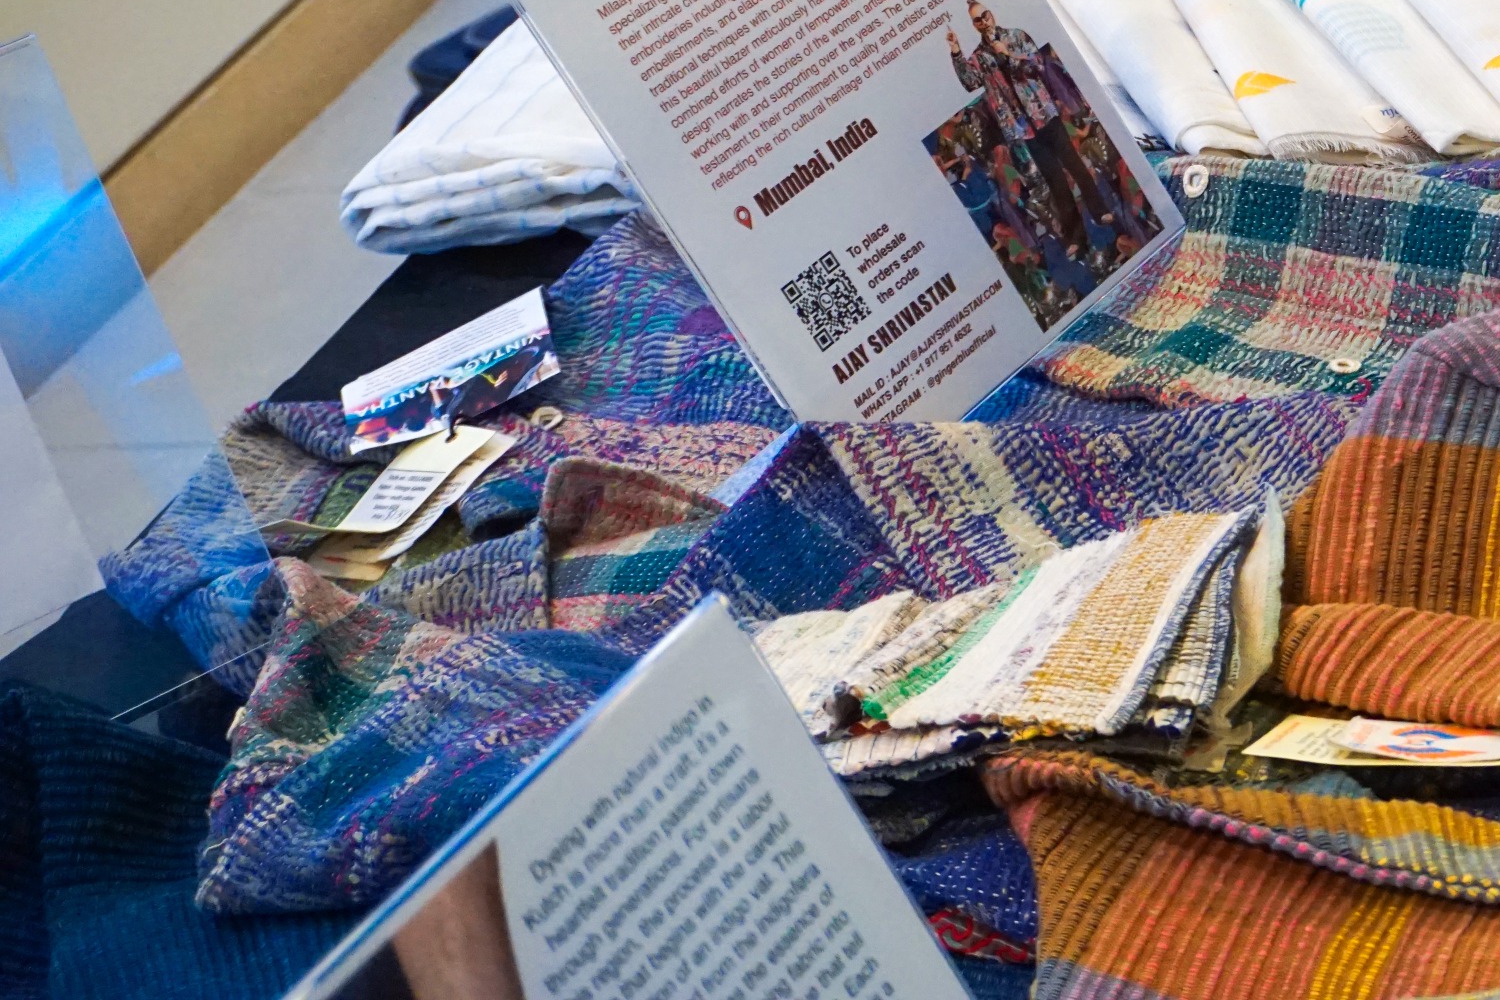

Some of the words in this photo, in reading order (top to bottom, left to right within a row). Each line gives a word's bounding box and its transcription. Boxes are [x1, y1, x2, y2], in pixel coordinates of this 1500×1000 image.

[618, 30, 641, 50] their
[642, 4, 681, 34] intricate
[630, 19, 692, 65] embroideries
[640, 26, 717, 81] embellishments,
[717, 9, 736, 28] and
[649, 58, 698, 96] traditional
[697, 24, 749, 63] techniques
[749, 10, 770, 26] with
[659, 96, 679, 112] this
[678, 64, 721, 99] beautiful
[719, 45, 750, 69] blazer
[751, 5, 808, 48] meticulously
[670, 88, 718, 128] combined
[718, 69, 748, 94] efforts
[759, 36, 794, 64] women
[681, 116, 714, 143] design
[714, 88, 753, 119] narrates
[753, 76, 770, 91] the
[771, 53, 802, 79] stories
[812, 34, 829, 48] the
[829, 10, 863, 36] women
[690, 128, 730, 159] working
[729, 113, 749, 130] with
[750, 97, 769, 116] and
[769, 63, 819, 102] supporting
[818, 48, 838, 66] over
[838, 37, 855, 51] the
[855, 18, 883, 42] years.
[881, 3, 902, 18] The
[700, 135, 749, 174] testament
[759, 111, 781, 131] their
[782, 70, 838, 115] commitment
[849, 42, 878, 67] quality
[879, 26, 897, 45] and
[897, 7, 926, 31] artistic
[711, 154, 757, 190] reflecting
[755, 142, 772, 157] the
[772, 128, 791, 145] rich
[791, 100, 825, 131] cultural
[824, 75, 862, 106] heritage
[872, 47, 901, 70] Indian
[901, 10, 952, 50] embroidery.
[753, 148, 834, 216] Mumbai,
[825, 118, 877, 162] India
[845, 245, 861, 257] To
[861, 223, 889, 250] place
[857, 232, 906, 273] wholesale
[867, 260, 900, 288] orders
[900, 240, 925, 262] scan
[876, 287, 894, 303] the
[895, 267, 919, 289] code
[452, 334, 544, 378] VINTAGE
[832, 343, 869, 384] AJAY
[867, 272, 956, 353] SHRIVASTAV
[853, 387, 875, 408] MAIL
[874, 377, 884, 390] ID
[890, 279, 1002, 378] AJAY@AJAYSHRIVASTAV.COM
[861, 390, 892, 418] WHATS
[893, 375, 908, 395] APP
[915, 363, 924, 375] +1
[924, 350, 937, 367] 917
[939, 339, 952, 354] 951
[954, 323, 972, 341] 4632
[879, 388, 922, 427] STAGRAM
[528, 827, 584, 883] Dyeing
[582, 797, 613, 829] with
[613, 749, 658, 800] natural
[659, 710, 697, 751] indigo
[583, 831, 620, 871] more
[619, 799, 652, 832] than
[604, 831, 659, 890] tradition
[660, 779, 707, 836] passed
[708, 744, 743, 784] down
[544, 934, 601, 991] through
[682, 821, 706, 848] For
[708, 768, 759, 824] artisans
[647, 918, 695, 969] begins
[695, 887, 722, 918] with
[745, 812, 789, 865] careful
[664, 854, 716, 915] process
[738, 791, 772, 829] labor
[711, 898, 748, 944] indigo
[772, 839, 804, 871] This
[845, 957, 878, 994] Each
